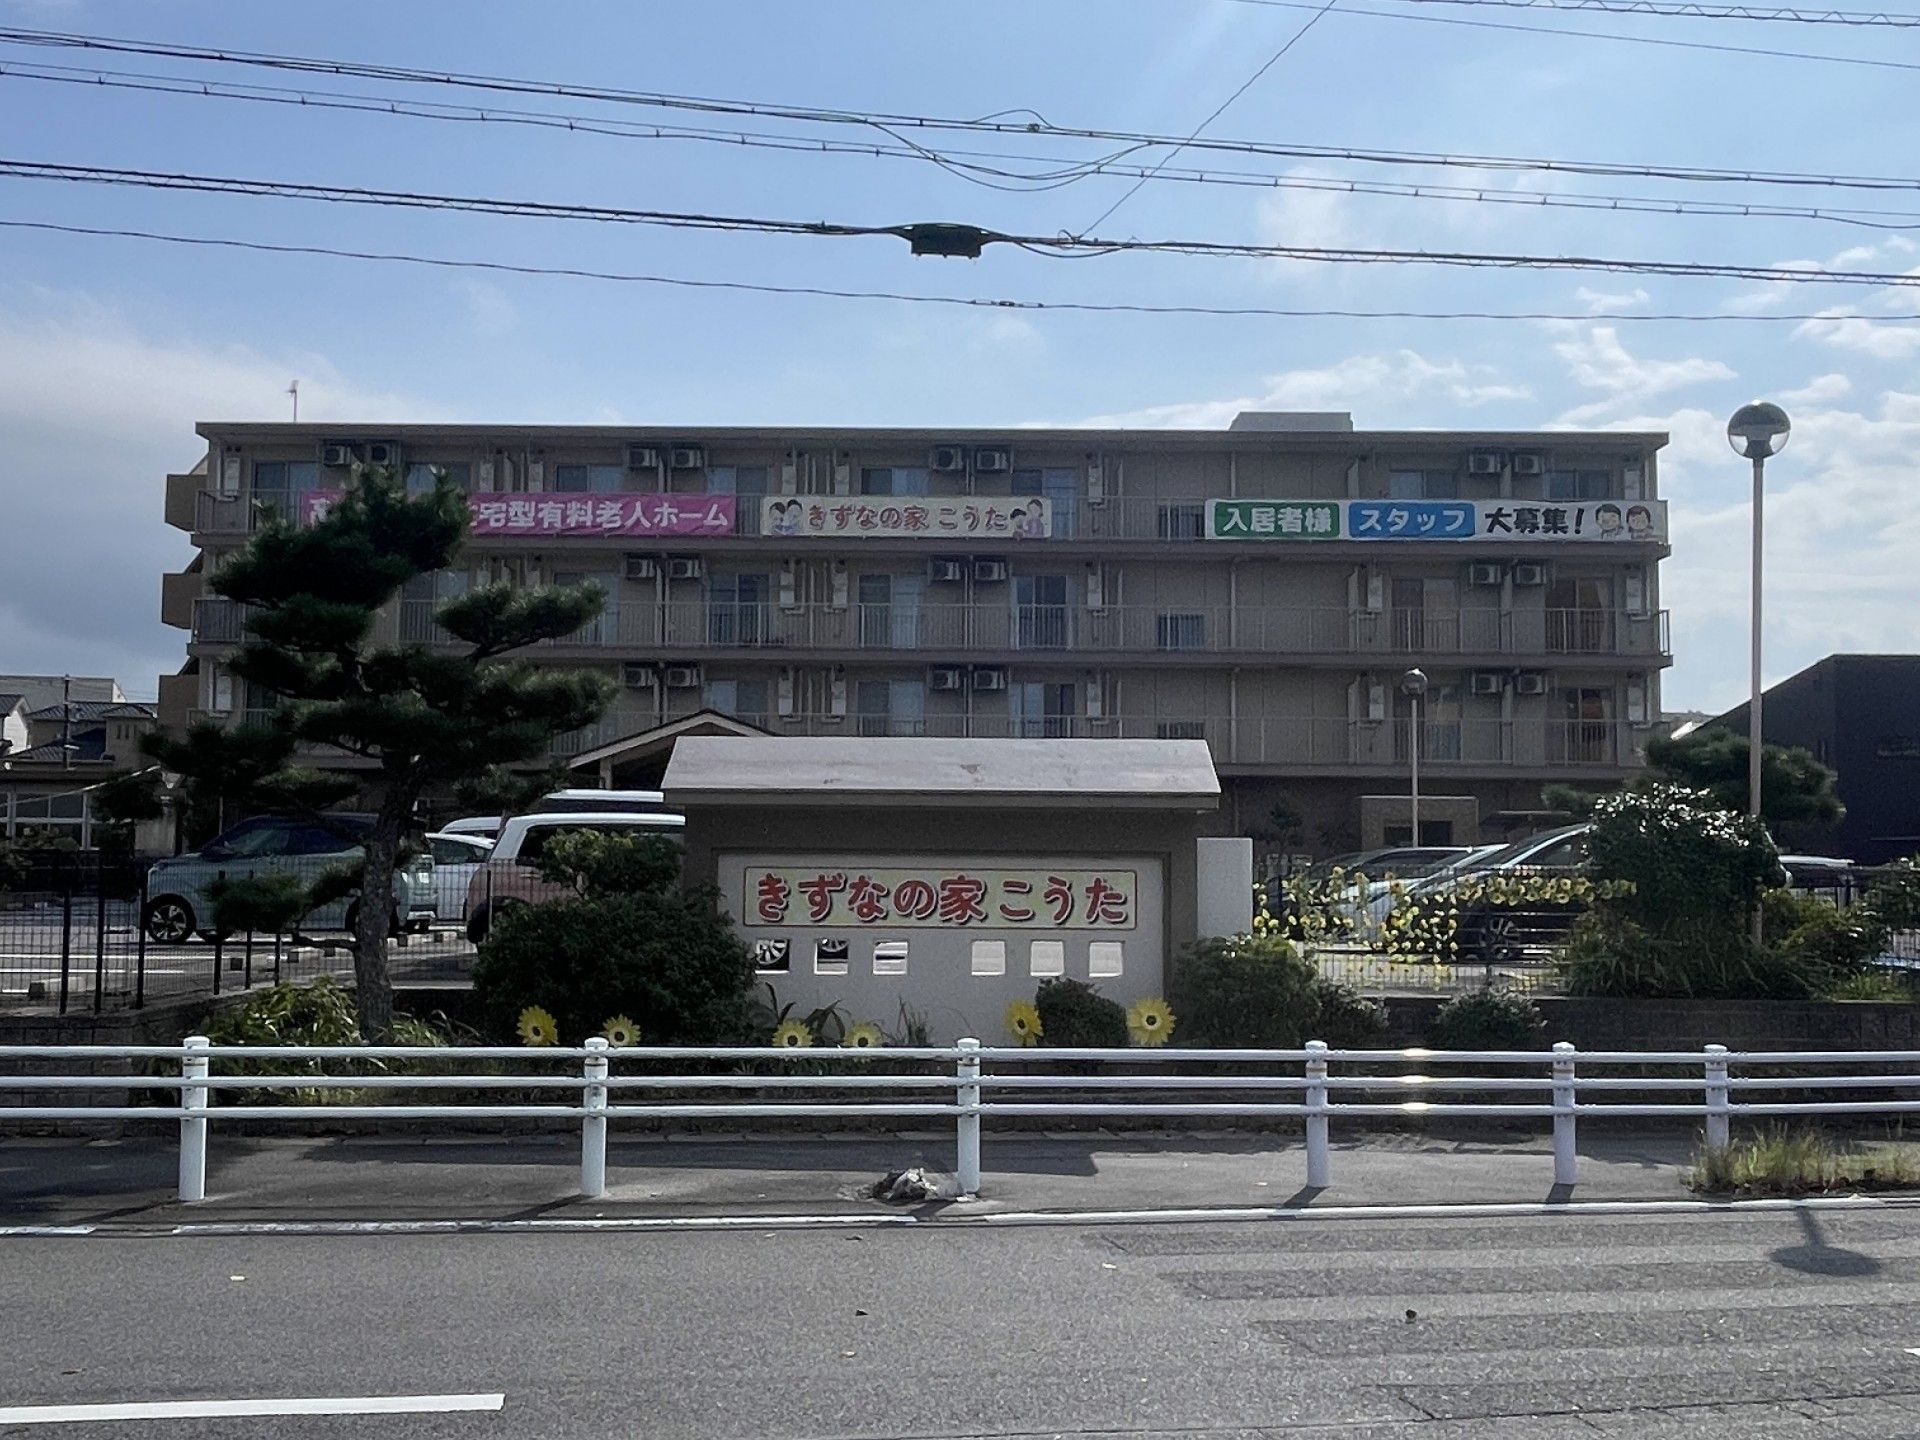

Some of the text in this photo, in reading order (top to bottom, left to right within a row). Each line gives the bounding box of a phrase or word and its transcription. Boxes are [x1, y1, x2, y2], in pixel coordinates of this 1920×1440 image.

[1222, 507, 1332, 534] 入居者様
[1358, 509, 1466, 533] スタッフ
